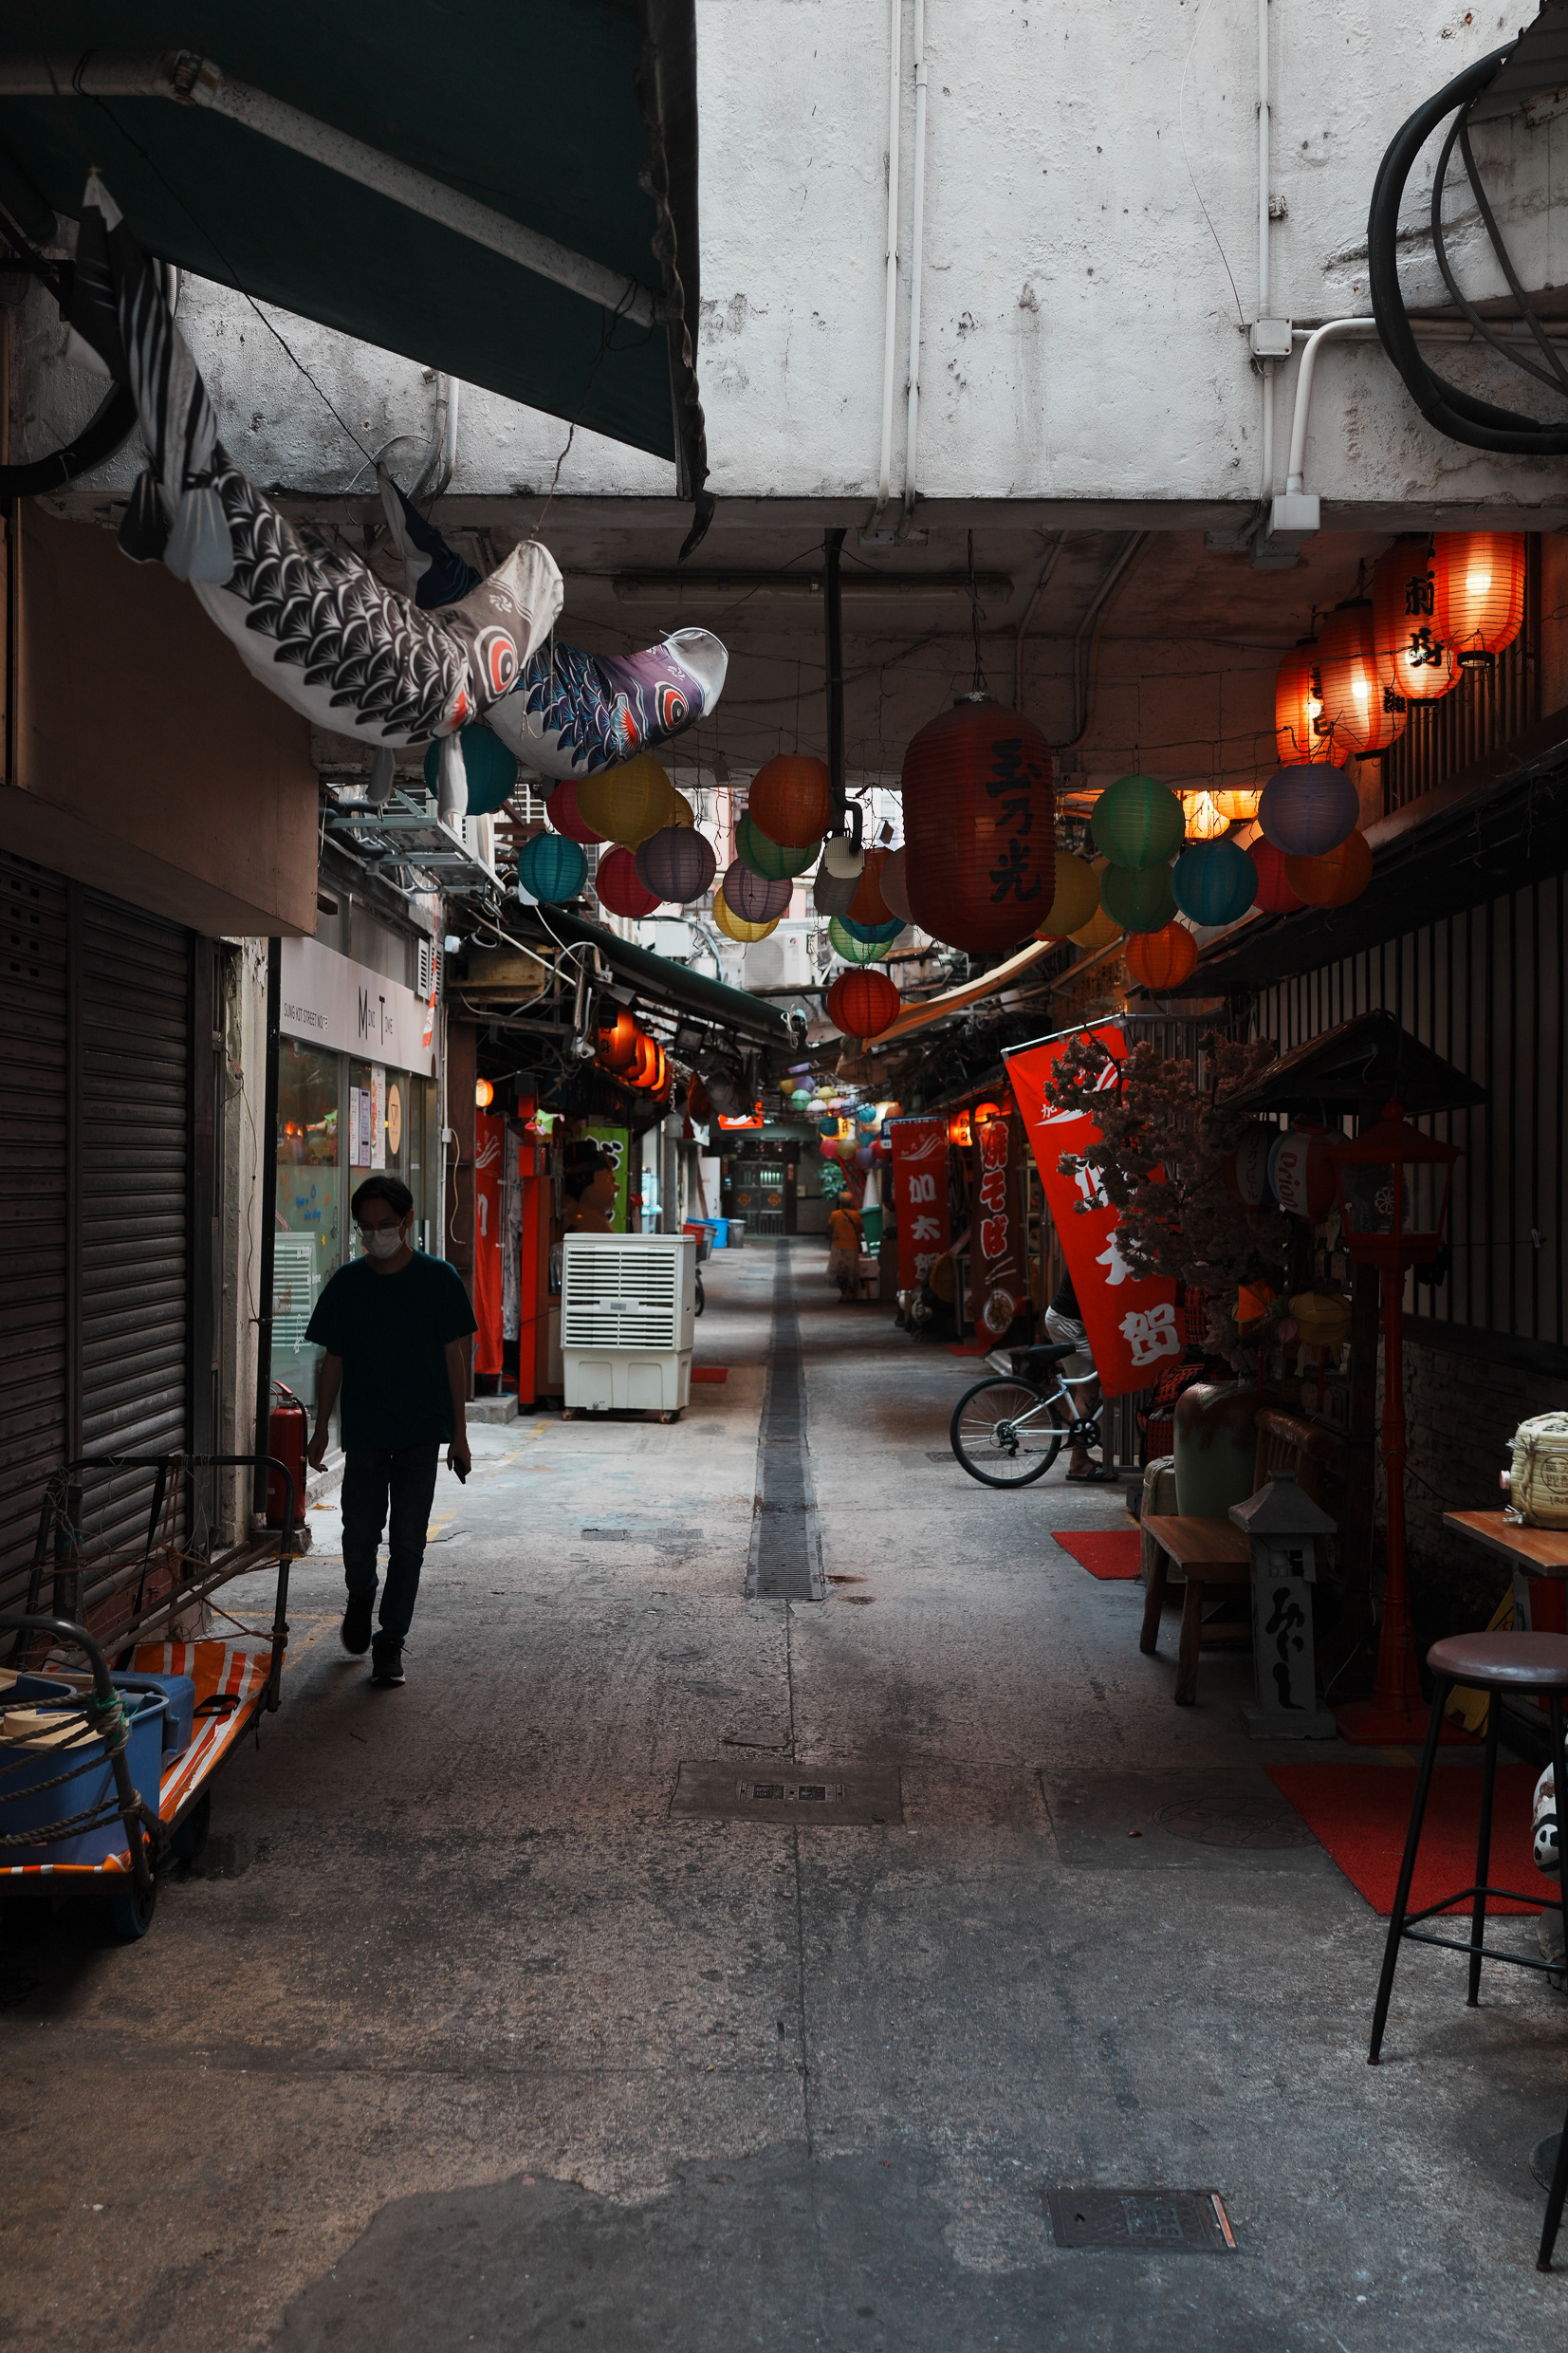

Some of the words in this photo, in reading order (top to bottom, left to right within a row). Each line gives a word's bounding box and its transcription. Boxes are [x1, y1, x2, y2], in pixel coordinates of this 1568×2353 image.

[986, 738, 1042, 902] 玉乃光
[303, 1010, 317, 1028] STREET
[1278, 1151, 1301, 1209] Orion
